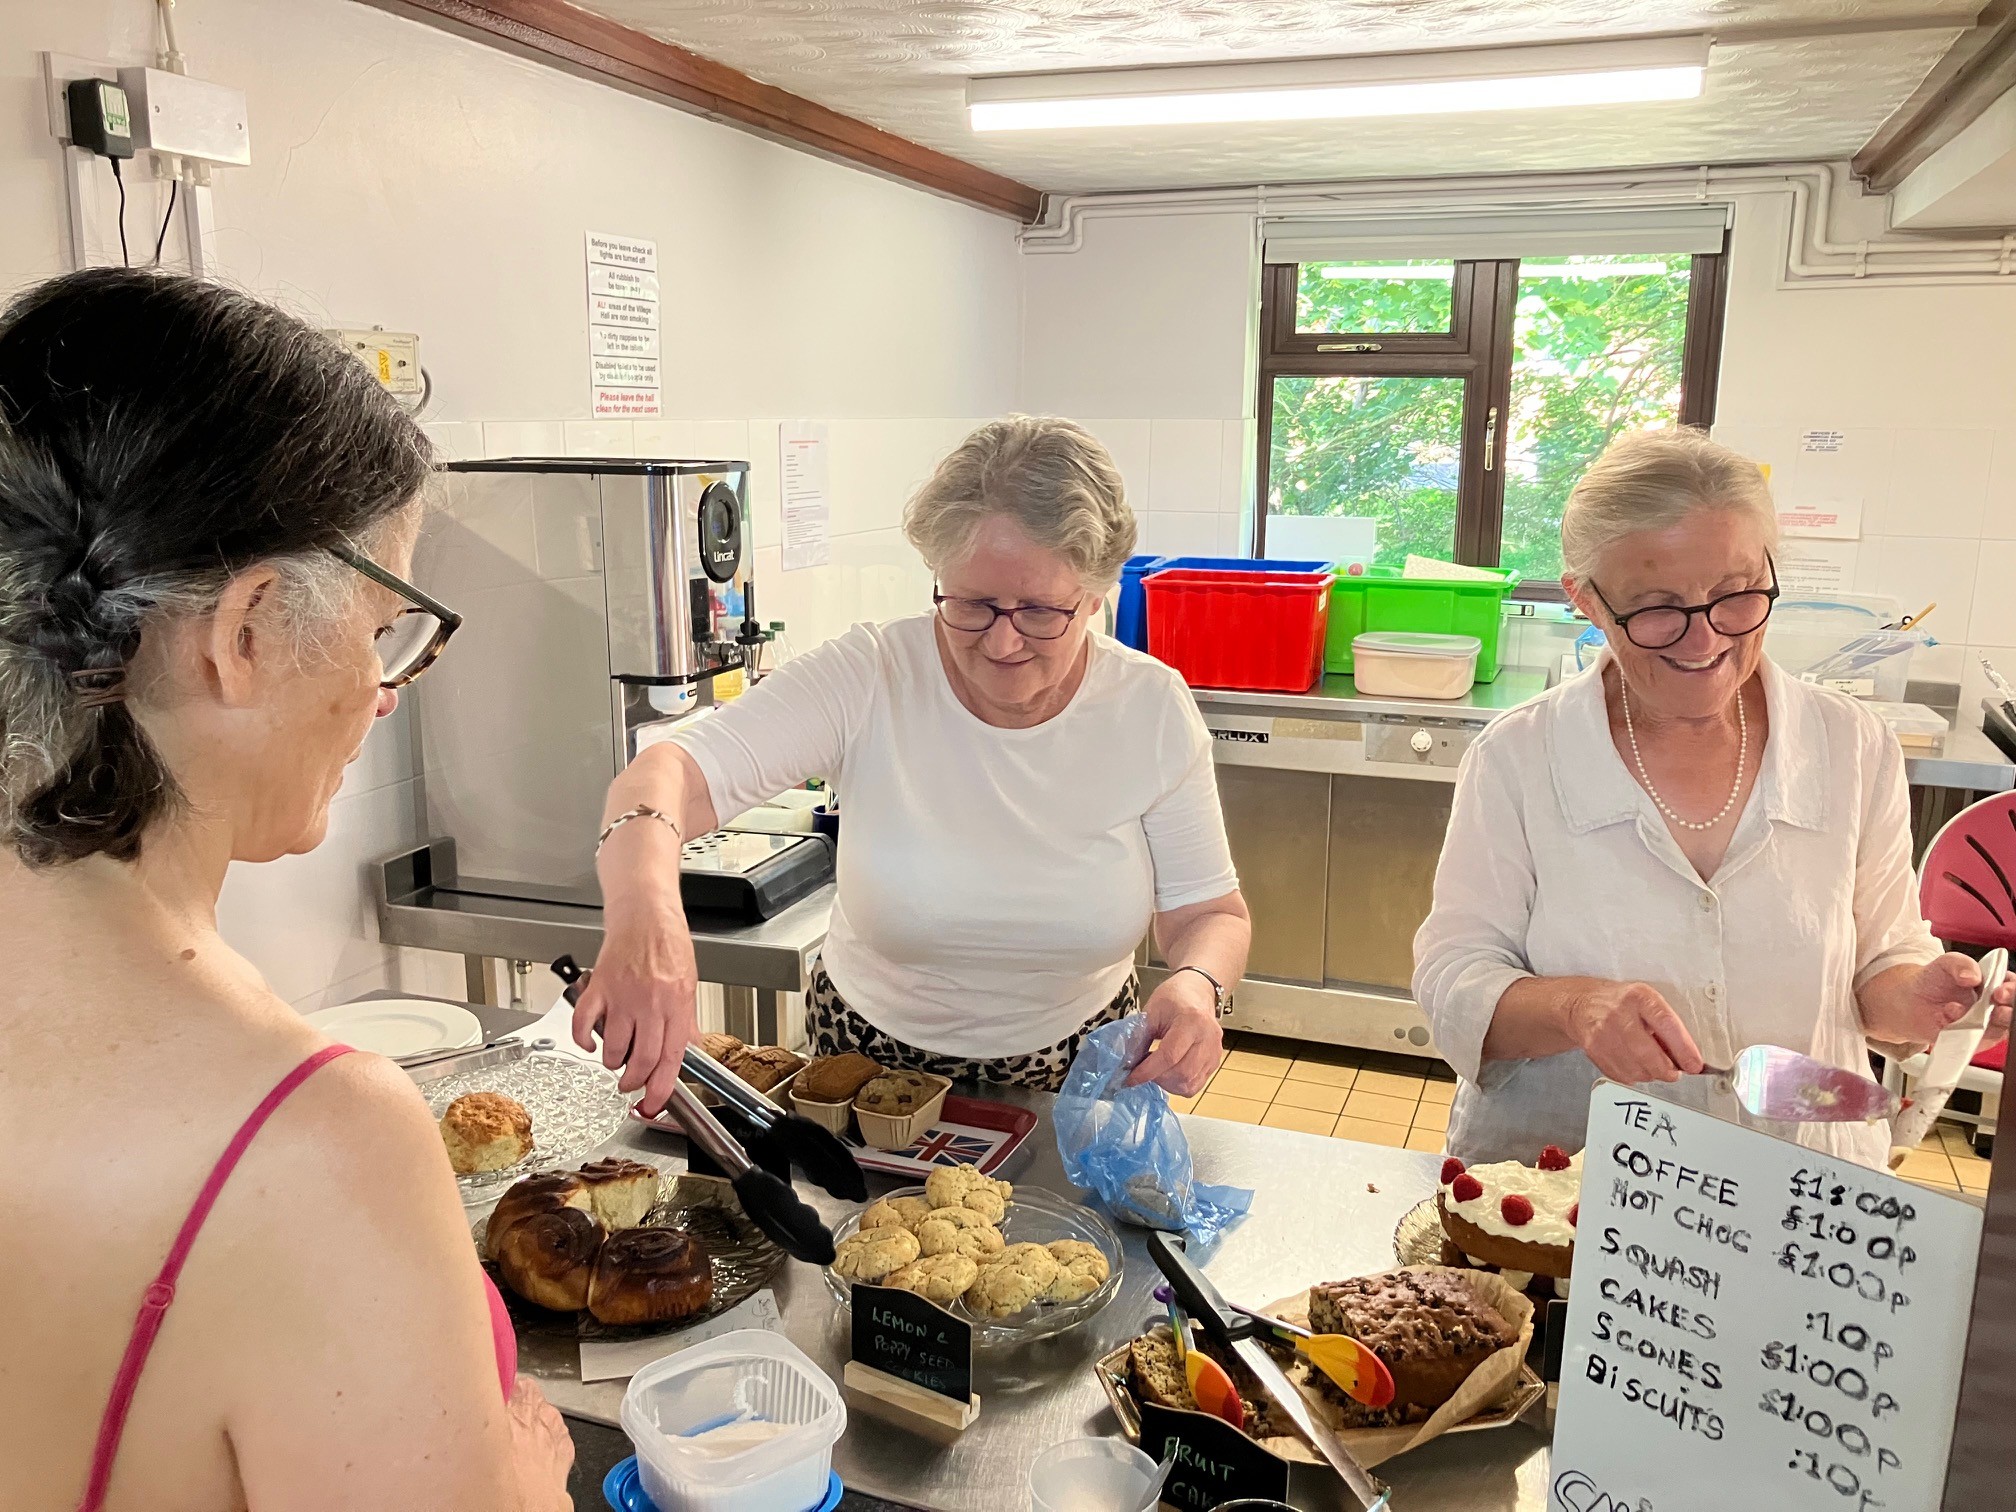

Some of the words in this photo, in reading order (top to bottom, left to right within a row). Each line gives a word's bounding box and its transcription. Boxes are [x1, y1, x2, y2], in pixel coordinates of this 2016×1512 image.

[591, 238, 608, 248] Before
[609, 243, 618, 251] you
[619, 243, 631, 252] leave
[632, 246, 646, 254] check
[600, 250, 613, 260] lights
[623, 254, 638, 263] turned
[616, 273, 634, 282] rubbish
[608, 282, 614, 290] be
[636, 305, 651, 315] Village
[600, 312, 610, 320] Hall
[629, 315, 649, 325] smoking
[608, 333, 618, 342] dirty
[619, 334, 637, 342] nappies
[595, 361, 616, 370] Disabled
[644, 374, 654, 383] only
[600, 392, 619, 402] Please
[621, 393, 634, 402] leave
[636, 393, 644, 402] the
[645, 393, 655, 402] hall
[595, 404, 611, 413] clean
[613, 404, 621, 413] for
[622, 404, 630, 413] the
[631, 405, 643, 413] next
[713, 549, 735, 563] Lincat
[1614, 1101, 1677, 1147] TEA
[1613, 1142, 1739, 1207] COFFEE
[1610, 1177, 1664, 1216] HOT
[1674, 1206, 1752, 1254] CHOC
[1599, 1227, 1721, 1300] SQUASH
[1600, 1278, 1717, 1340] CAKES
[872, 1306, 928, 1337] LEMON
[874, 1335, 911, 1361] POPPY
[919, 1352, 955, 1371] SEED
[1592, 1311, 1723, 1390] SCONES
[1164, 1436, 1235, 1482] FRUIT
[1172, 1481, 1214, 1509] CAK
